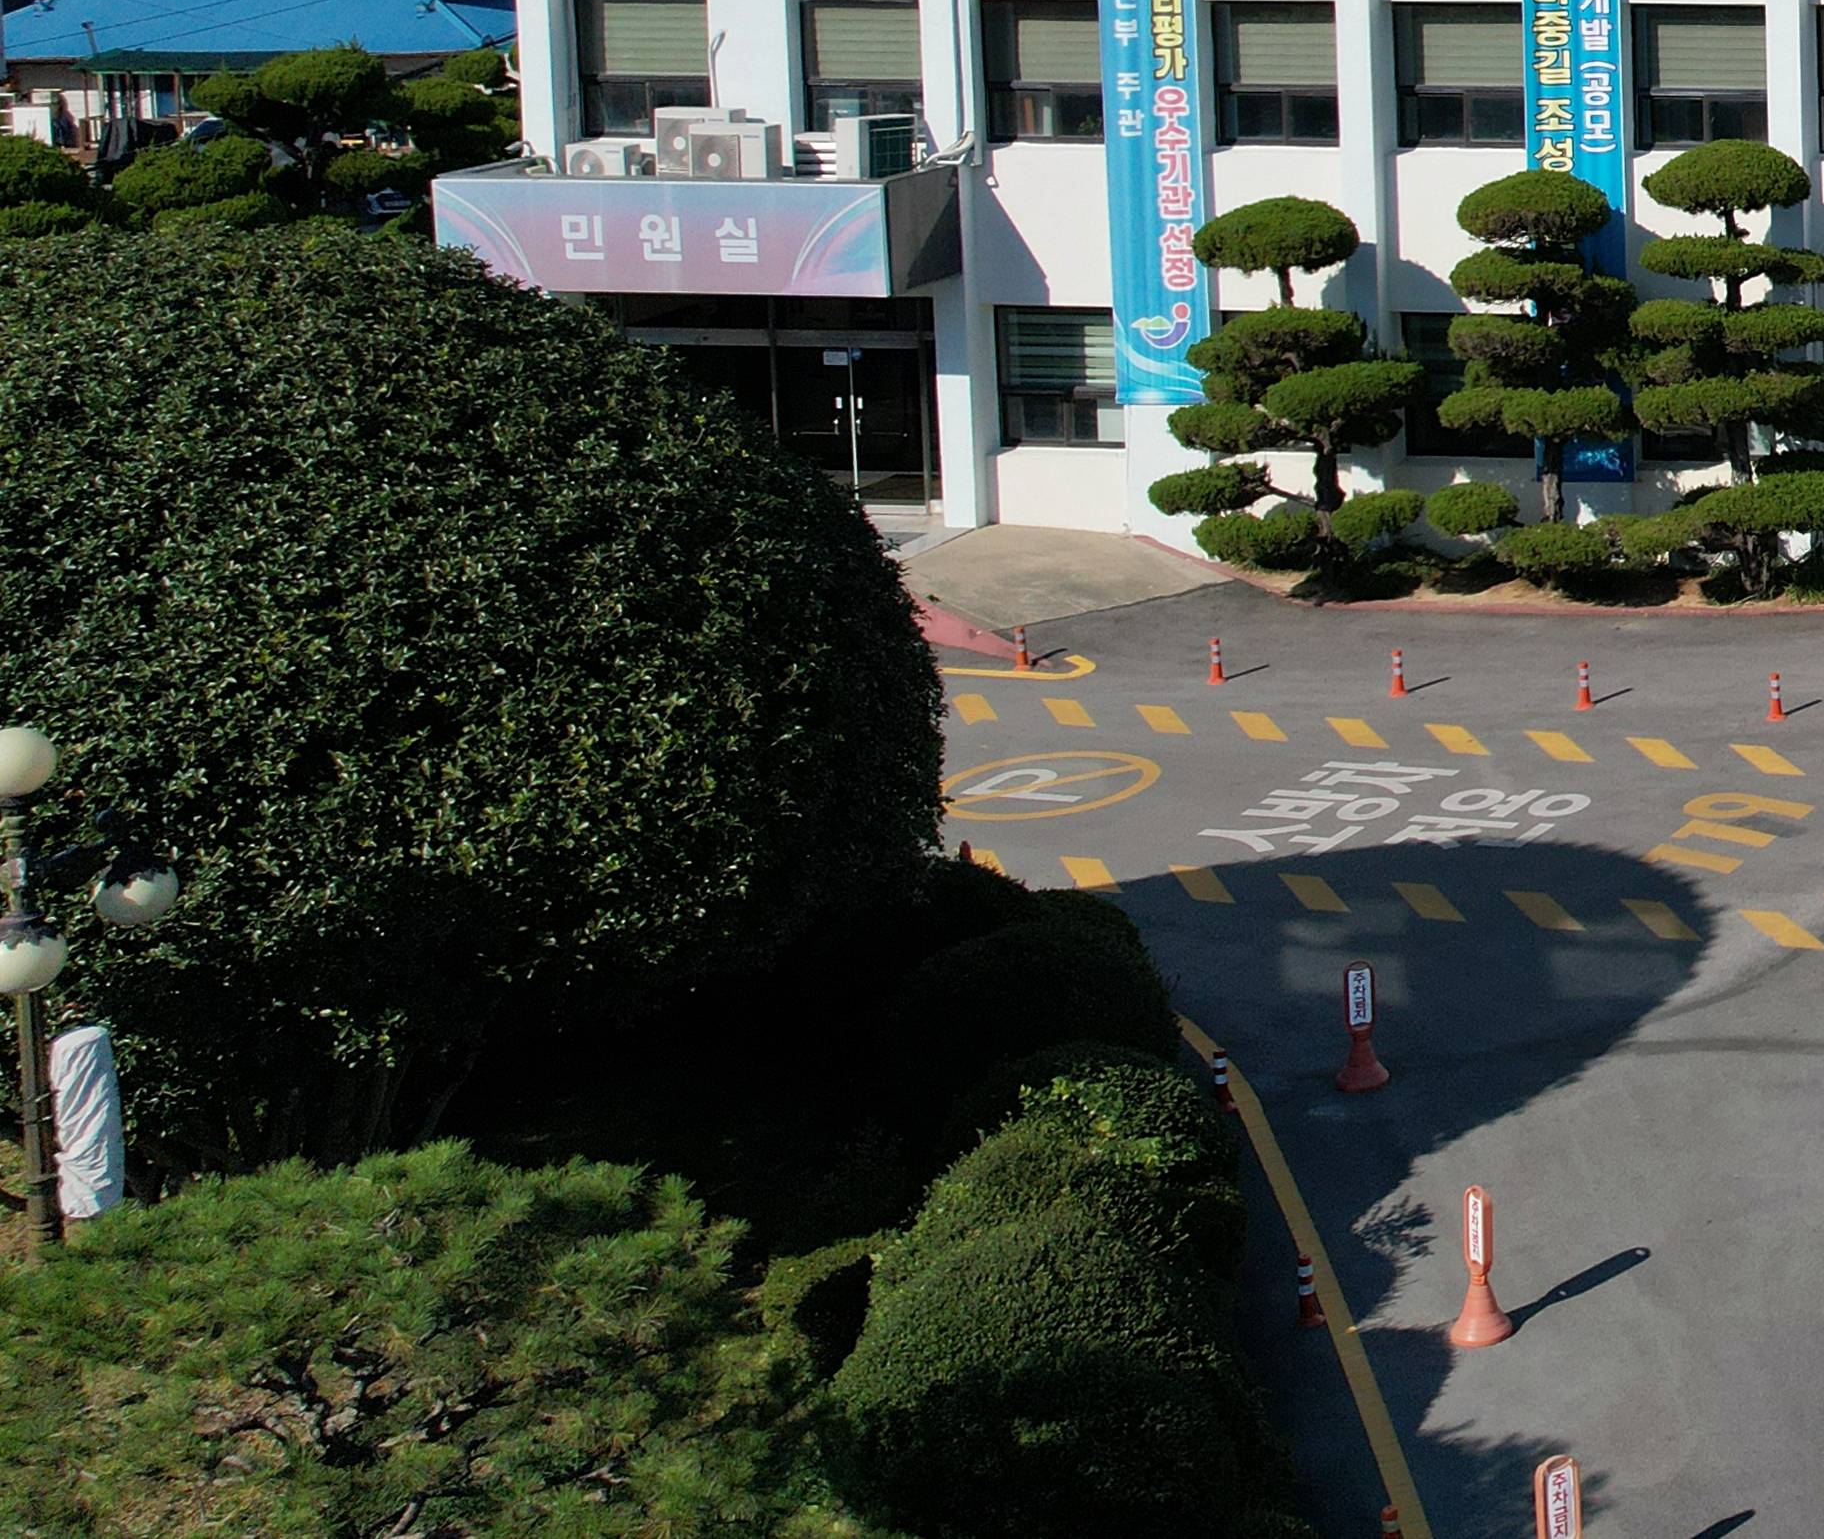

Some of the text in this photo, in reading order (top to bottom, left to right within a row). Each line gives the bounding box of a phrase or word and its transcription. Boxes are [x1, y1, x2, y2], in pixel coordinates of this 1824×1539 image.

[1115, 71, 1145, 139] 주관
[1533, 95, 1576, 173] 조성
[1578, 60, 1617, 156] (공모)
[1151, 85, 1194, 219] 우수기관
[560, 213, 760, 264] 민원실
[1159, 223, 1196, 292] 선정
[1353, 972, 1367, 1020] 주차금지
[1552, 1471, 1569, 1538] 주차금지
